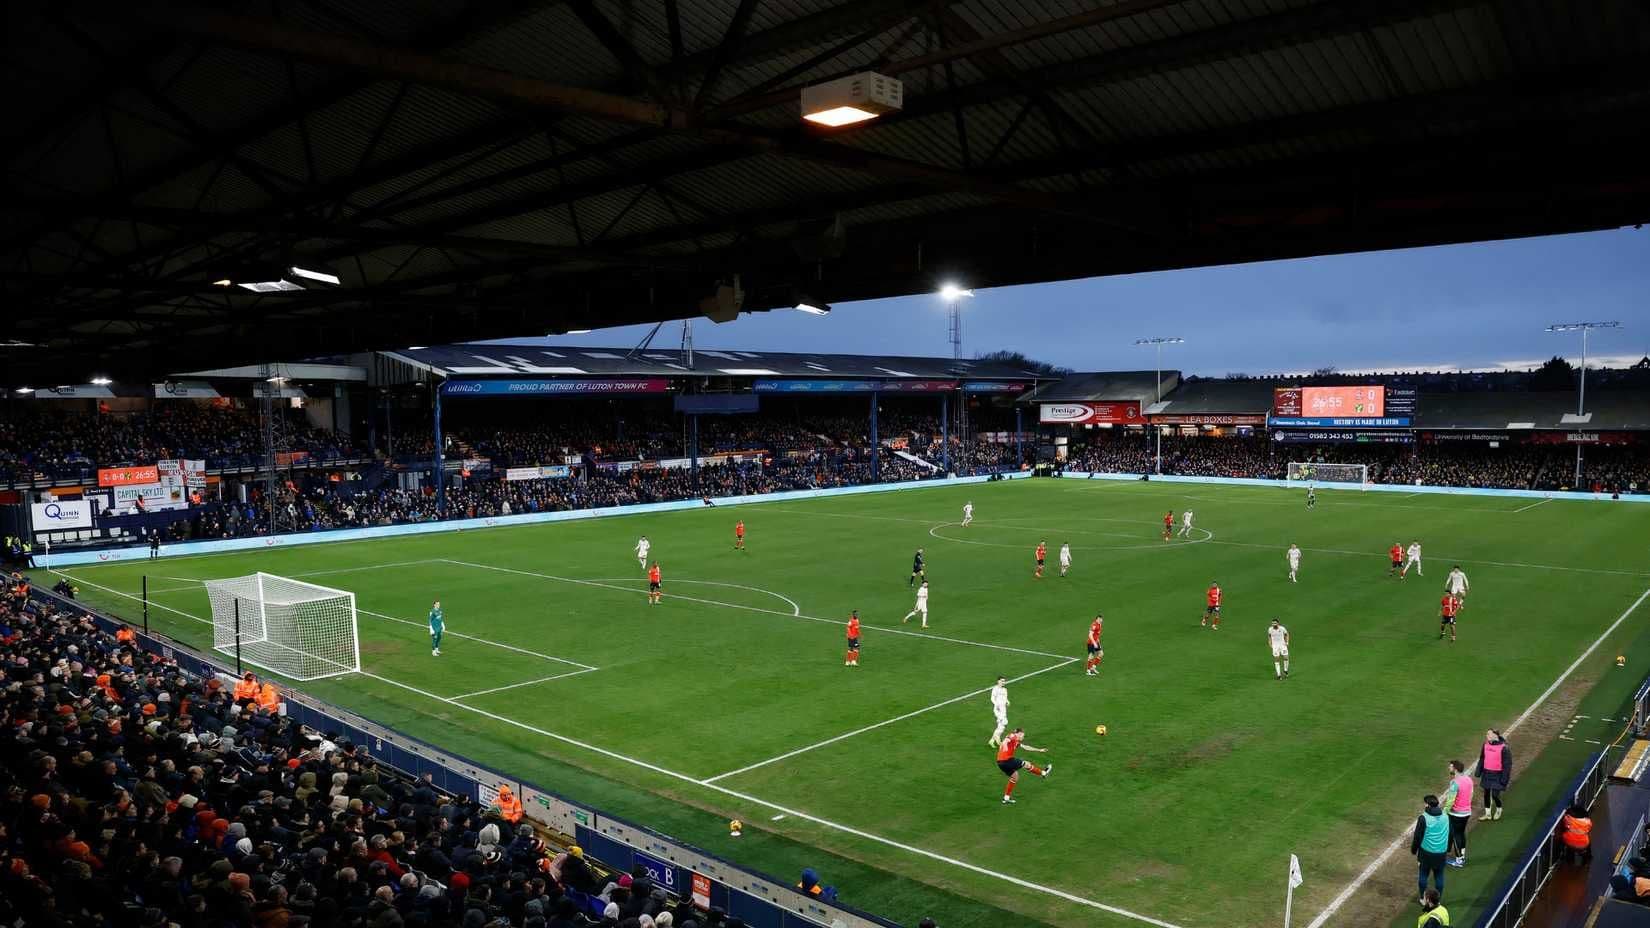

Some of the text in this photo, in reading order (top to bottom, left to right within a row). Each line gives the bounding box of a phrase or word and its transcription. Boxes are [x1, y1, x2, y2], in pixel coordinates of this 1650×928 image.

[448, 384, 475, 392] utilita
[539, 383, 574, 391] PARTNER
[1367, 390, 1375, 400] 0
[1367, 404, 1375, 414] 0
[1185, 416, 1201, 424] LEA
[1204, 416, 1233, 424] BOXES
[135, 471, 155, 480] 26:55
[143, 487, 153, 497] SKY
[45, 503, 79, 520] QUINN
[665, 867, 673, 886] B
